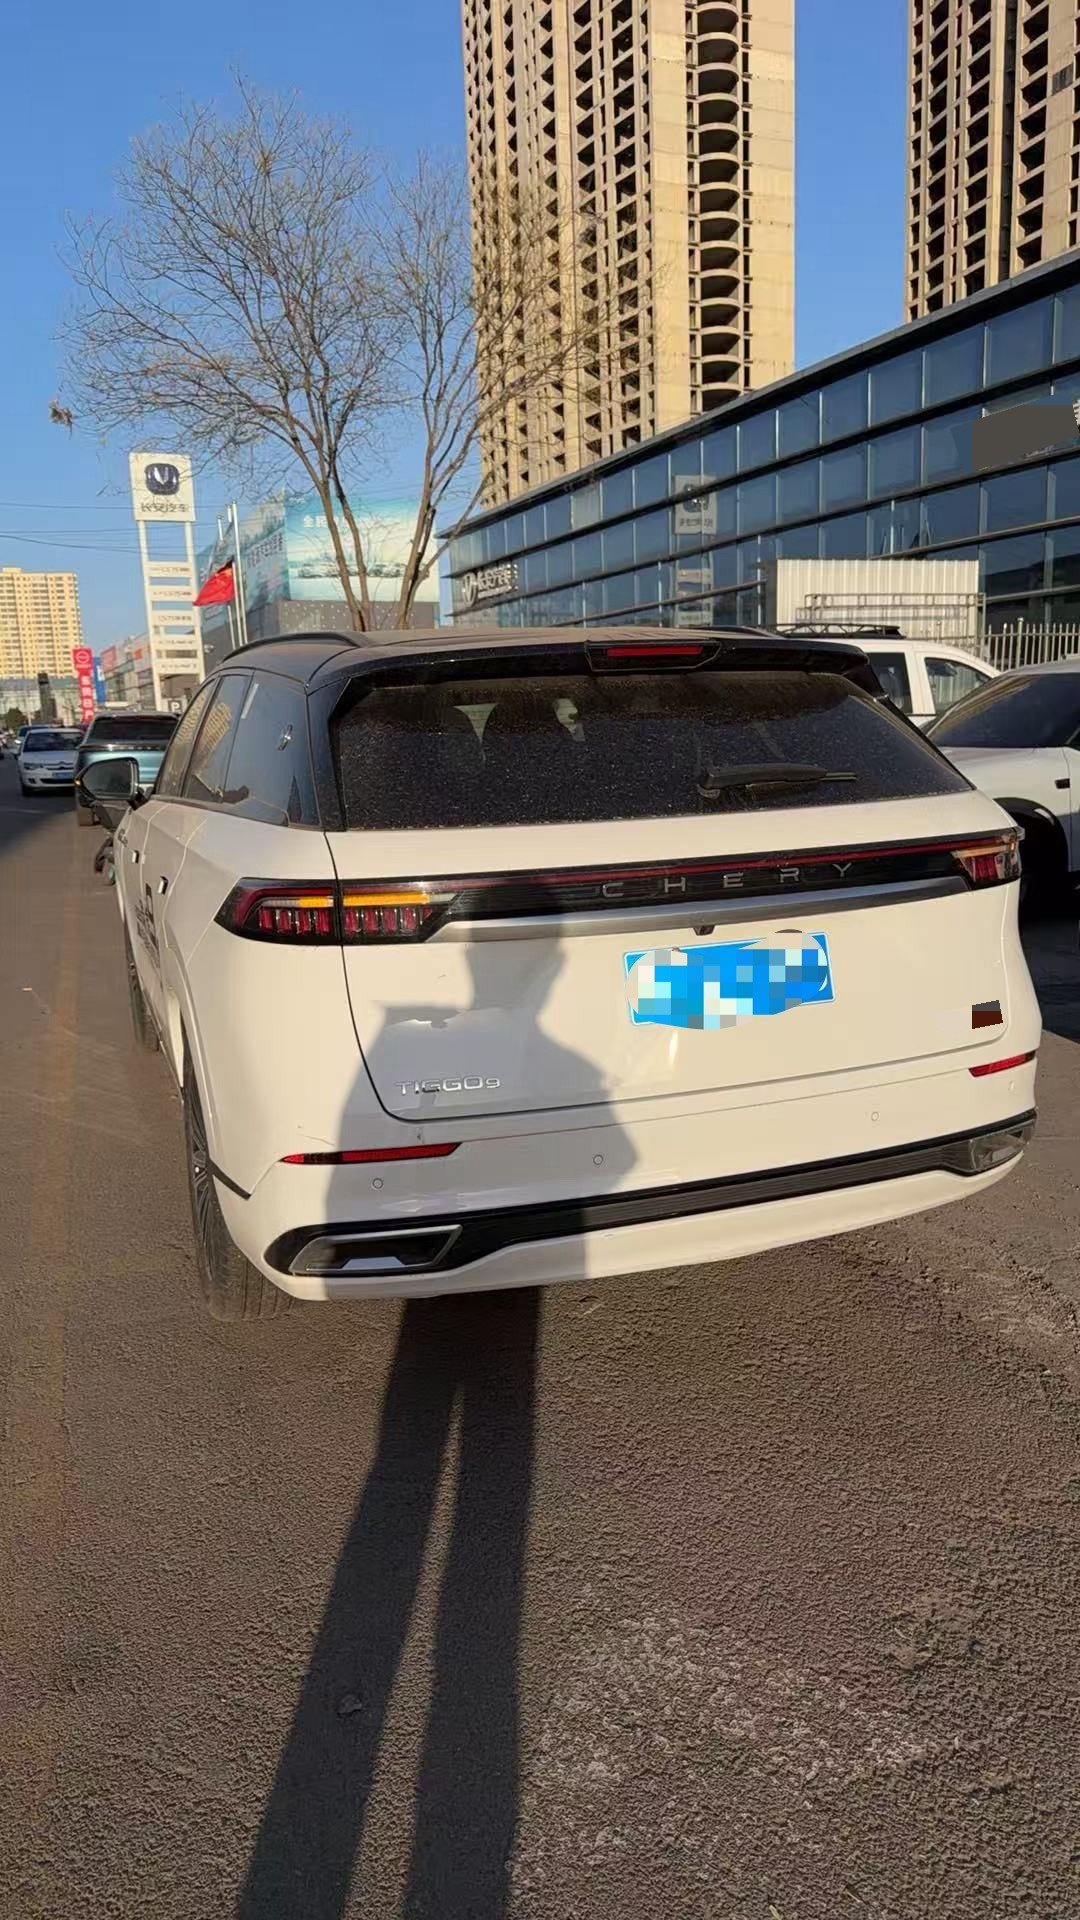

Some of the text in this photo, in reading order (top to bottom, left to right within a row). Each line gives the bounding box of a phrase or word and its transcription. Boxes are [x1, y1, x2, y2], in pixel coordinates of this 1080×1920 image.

[140, 502, 189, 514] 长安汽车
[170, 701, 180, 712] P
[602, 862, 852, 898] CHERY
